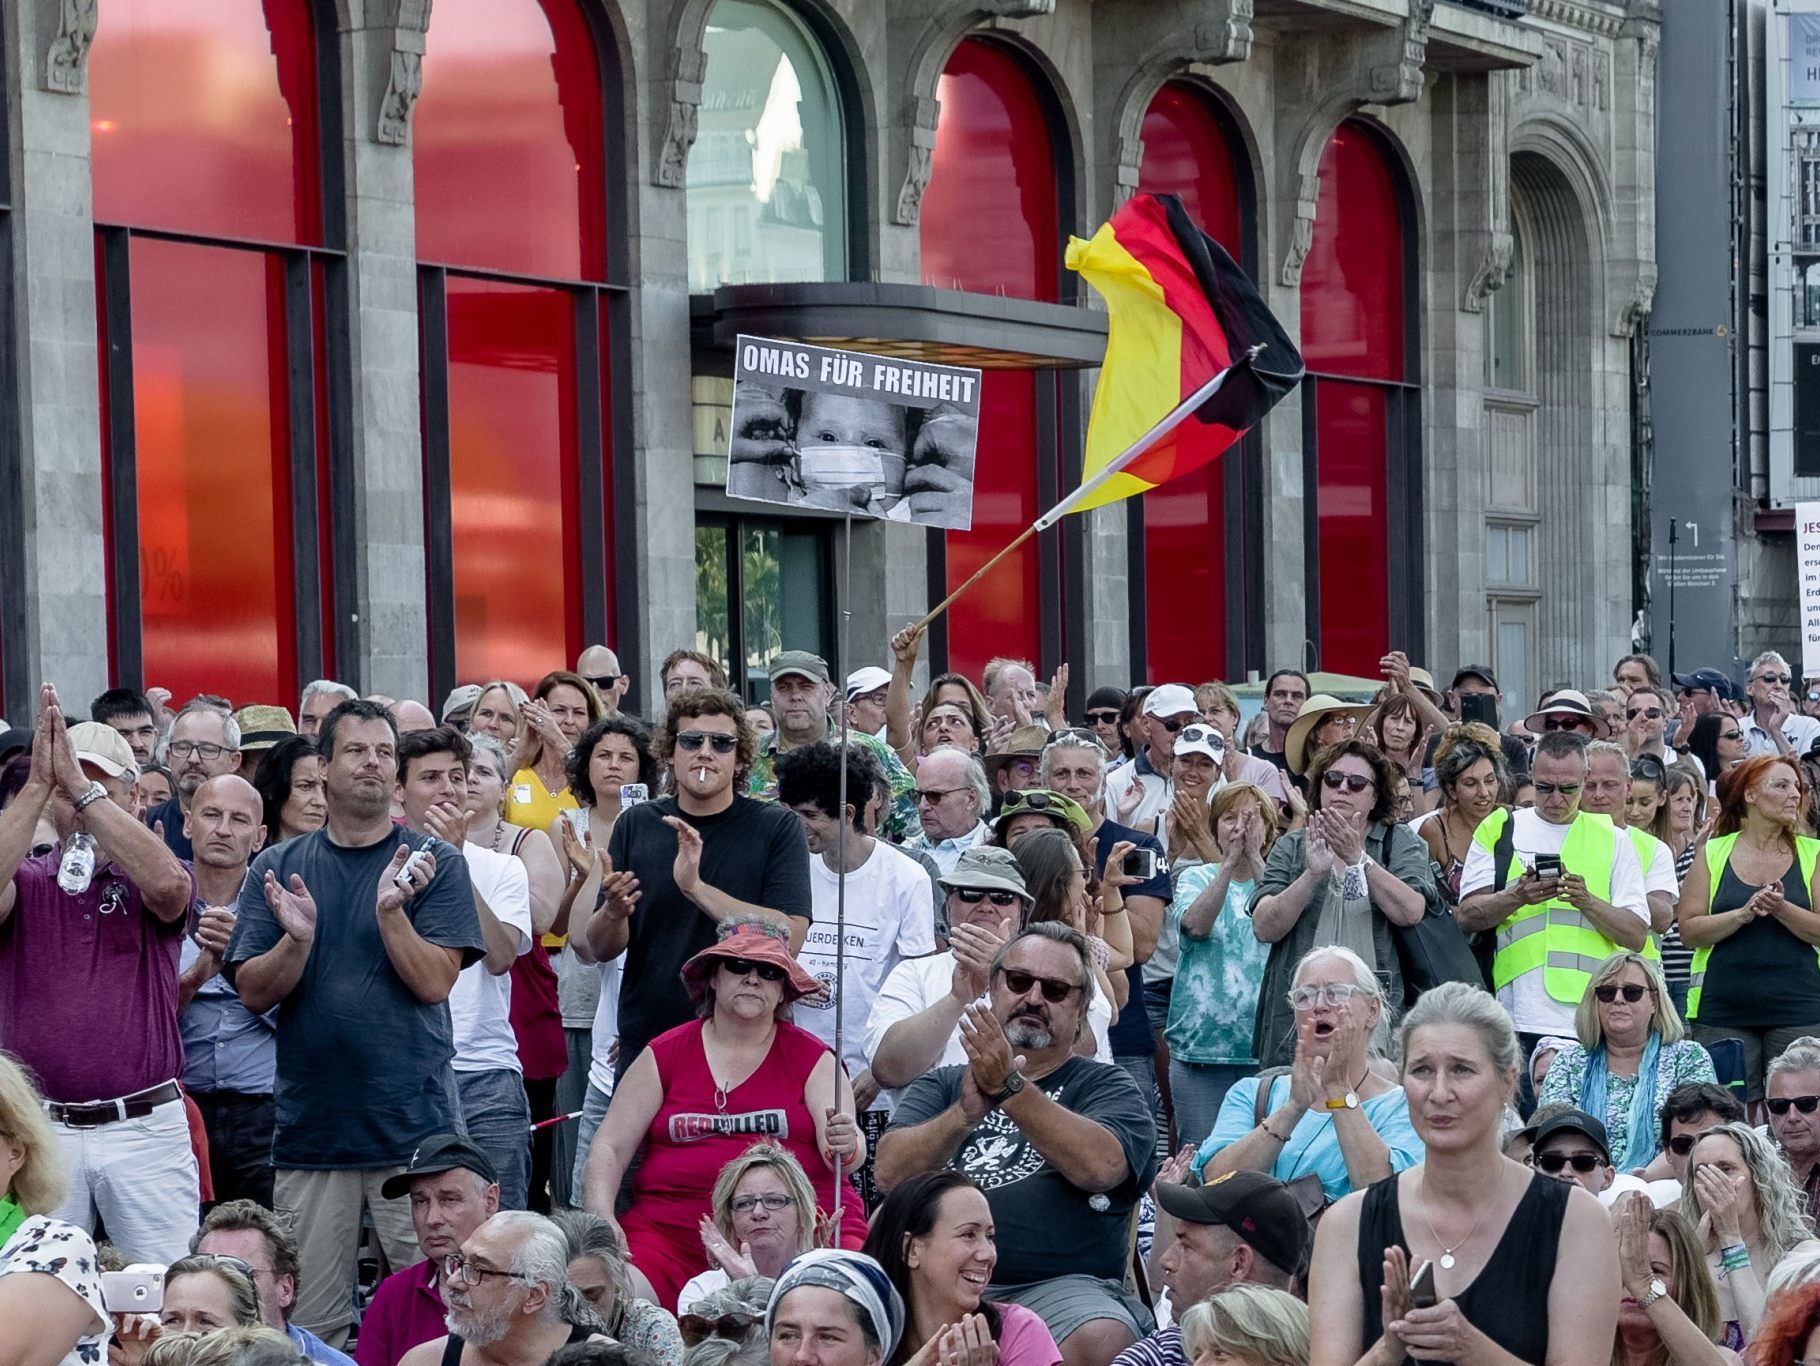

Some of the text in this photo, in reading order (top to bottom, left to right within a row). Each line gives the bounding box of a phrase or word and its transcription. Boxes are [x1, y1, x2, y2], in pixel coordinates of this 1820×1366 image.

[743, 345, 976, 402] OMAS FÜR FREIHEIT
[1805, 574, 1817, 582] im
[1808, 632, 1820, 642] für
[806, 931, 864, 948] UERDEKEN
